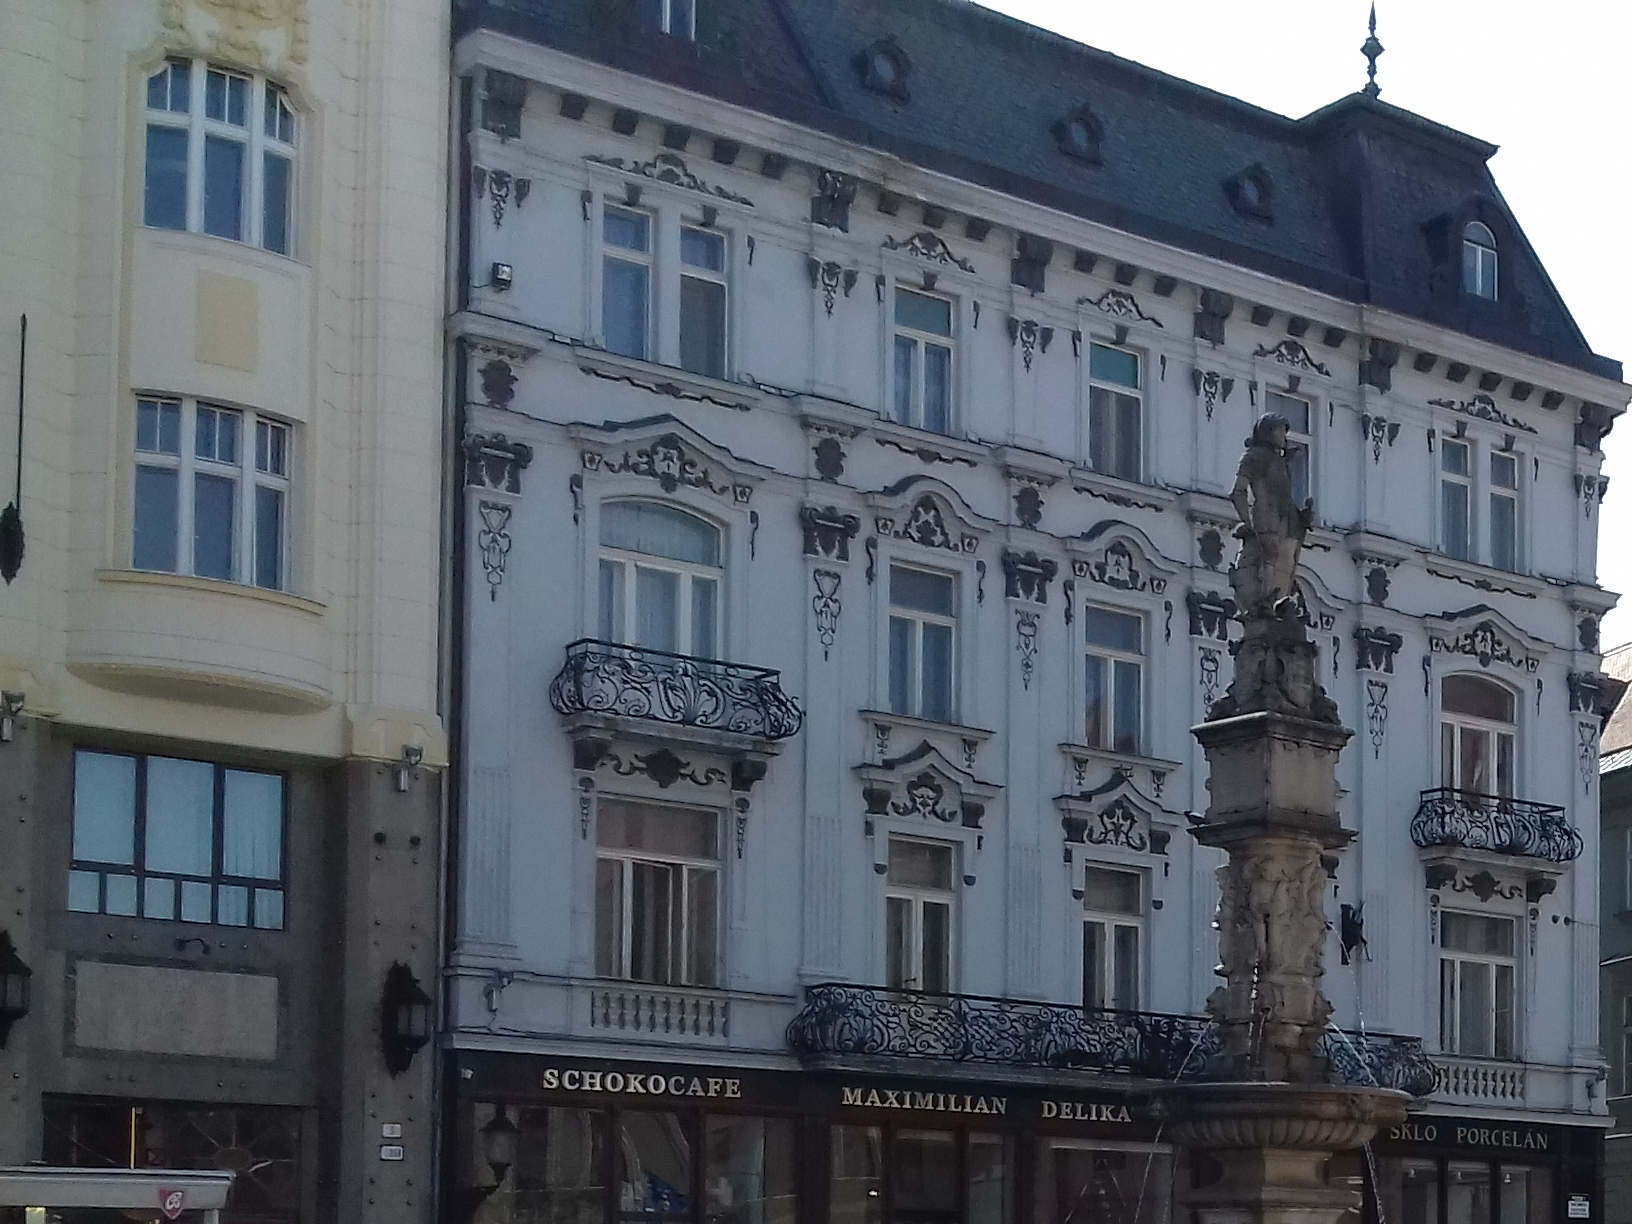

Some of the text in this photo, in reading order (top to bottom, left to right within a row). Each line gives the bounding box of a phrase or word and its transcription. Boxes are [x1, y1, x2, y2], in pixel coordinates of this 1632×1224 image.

[543, 1068, 742, 1098] SCHOKOCAFE
[841, 1086, 1133, 1123] MAXIMILIAN DELIKA
[1390, 1123, 1549, 1150] SKLO PORCELÁN
